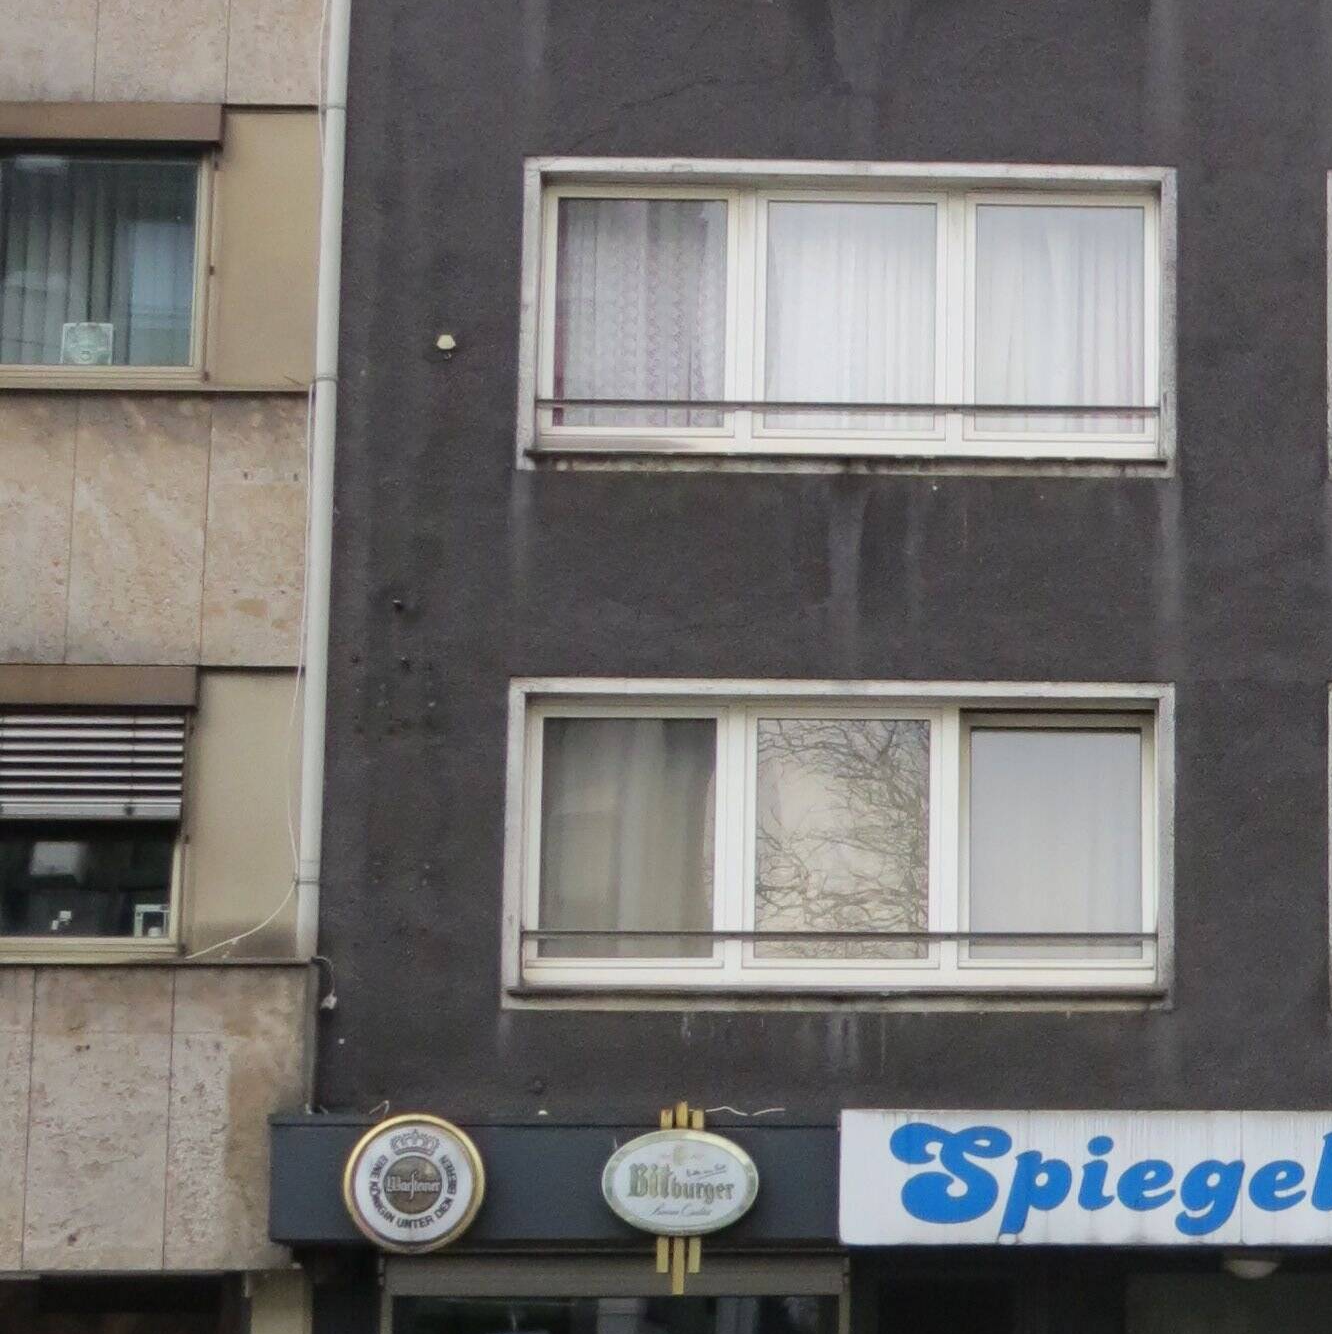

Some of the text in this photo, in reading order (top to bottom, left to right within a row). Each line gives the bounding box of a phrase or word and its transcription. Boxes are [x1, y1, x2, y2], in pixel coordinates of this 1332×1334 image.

[627, 1162, 735, 1204] Bitburger
[396, 1215, 435, 1229] UNTER
[433, 1196, 455, 1219] DEN
